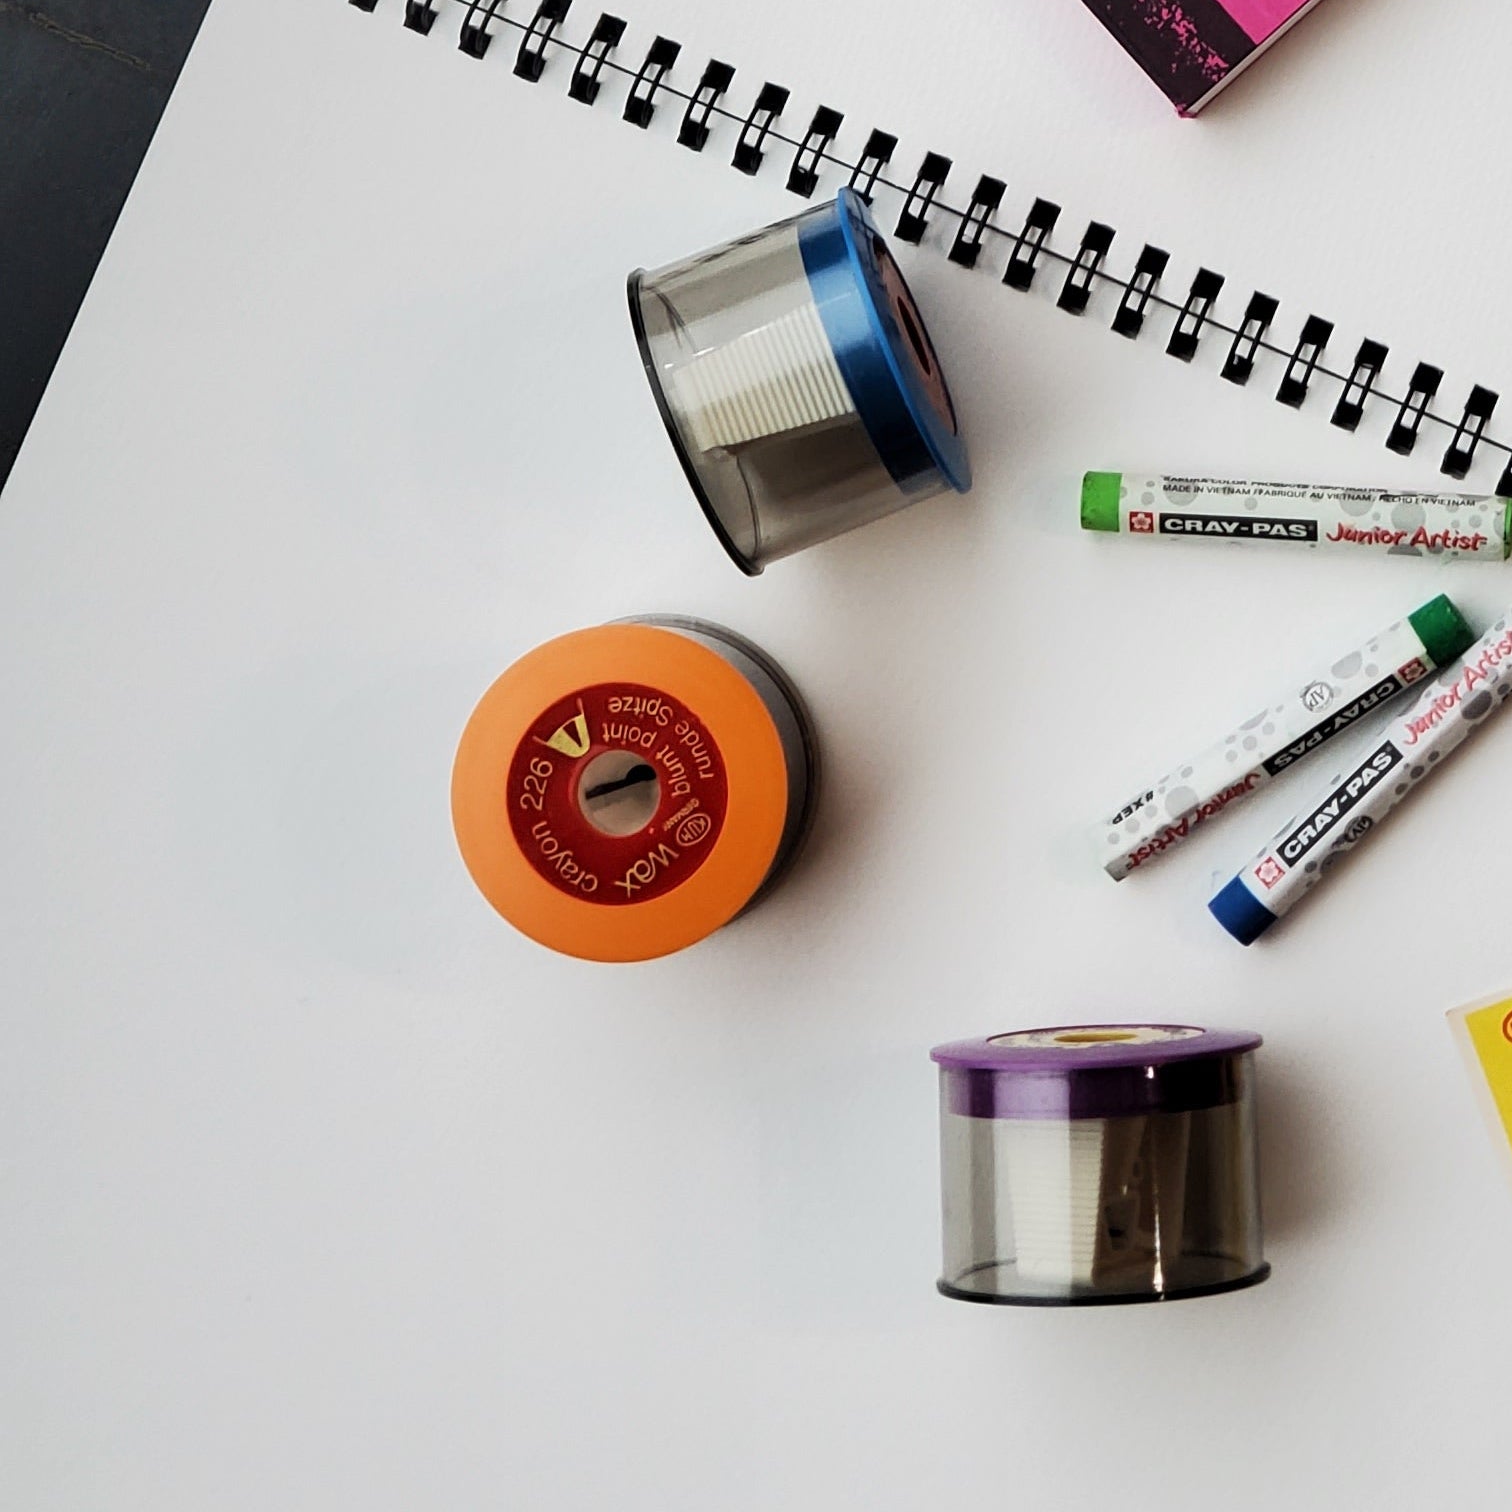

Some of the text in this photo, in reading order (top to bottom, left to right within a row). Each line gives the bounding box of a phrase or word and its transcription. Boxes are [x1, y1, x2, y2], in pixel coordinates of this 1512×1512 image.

[1164, 518, 1483, 552] CRAY-PAS Junior Artist
[602, 723, 691, 798] blunt point
[608, 696, 714, 779] runde Spitze
[1274, 681, 1395, 767] CRAY-PAS
[519, 757, 553, 811] 226
[1284, 749, 1393, 859] CRAY-PAS
[1402, 685, 1465, 746] Junior
[533, 821, 598, 893] crayon
[615, 843, 679, 898] wax
